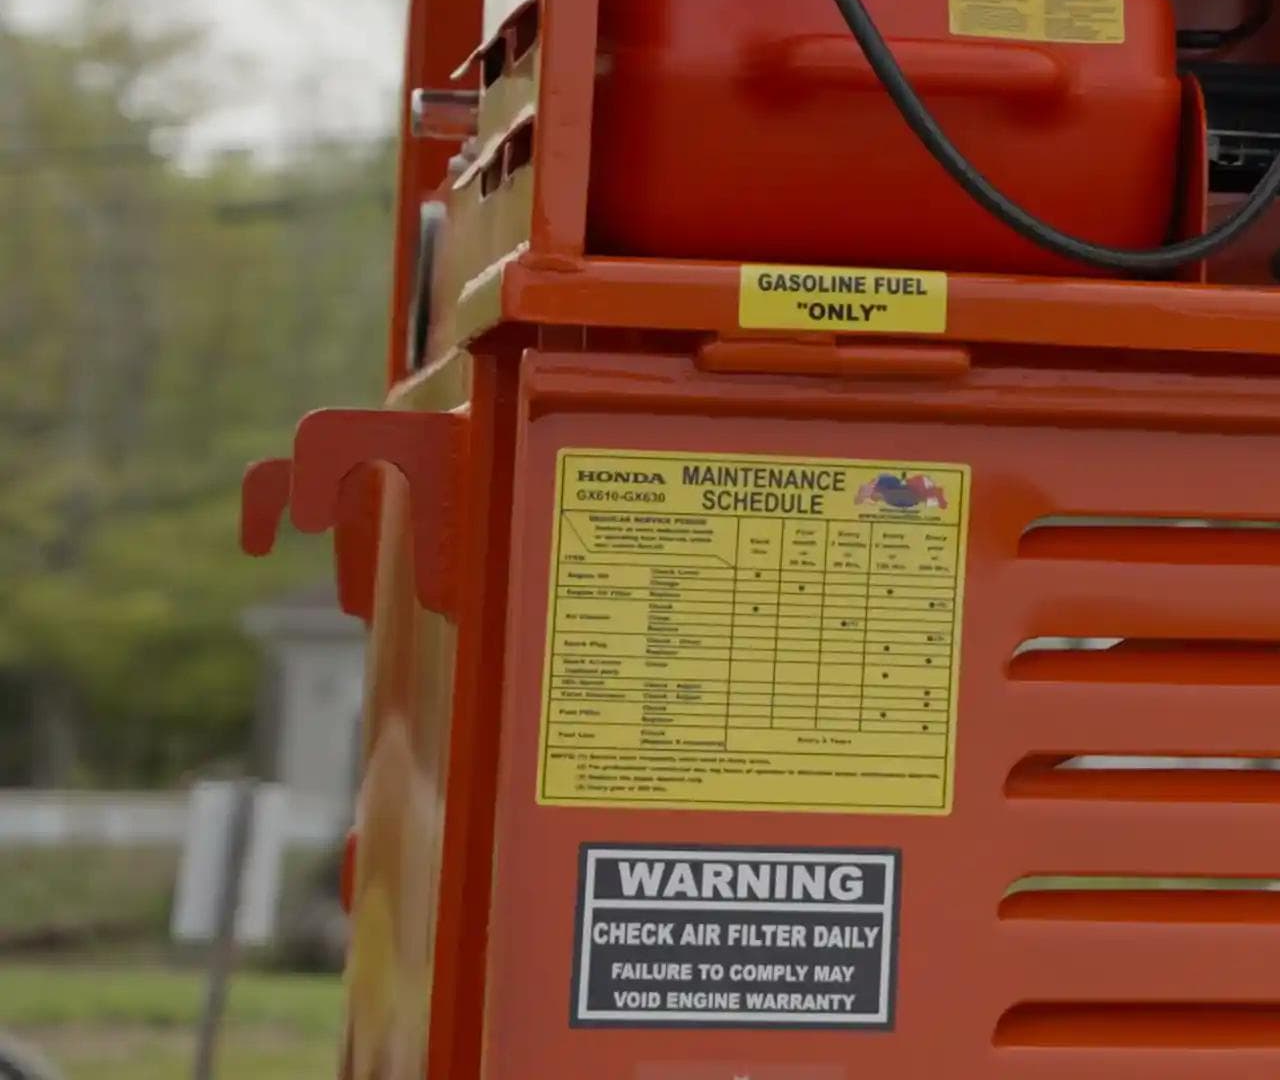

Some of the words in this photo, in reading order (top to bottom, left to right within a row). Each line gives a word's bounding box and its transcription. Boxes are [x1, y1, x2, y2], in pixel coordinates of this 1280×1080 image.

[758, 273, 866, 294] GASOLINE
[874, 277, 927, 296] FUEL
[797, 302, 887, 321] "ONLY"
[576, 470, 666, 485] HONDA
[682, 465, 846, 492] MAINTENANCE
[702, 489, 824, 515] SCHEDULE
[617, 861, 864, 901] WARNING
[592, 922, 675, 945] CHECK
[680, 923, 722, 946] AIR
[727, 924, 806, 948] FILTER
[813, 925, 880, 949] DAILY
[611, 962, 692, 981] FAILURE
[699, 964, 724, 981] TO
[729, 964, 808, 983] COMPLY
[814, 966, 855, 984] MAY
[613, 991, 661, 1009] VOID
[666, 992, 740, 1010] ENGINE
[745, 993, 855, 1011] WARRANTY
